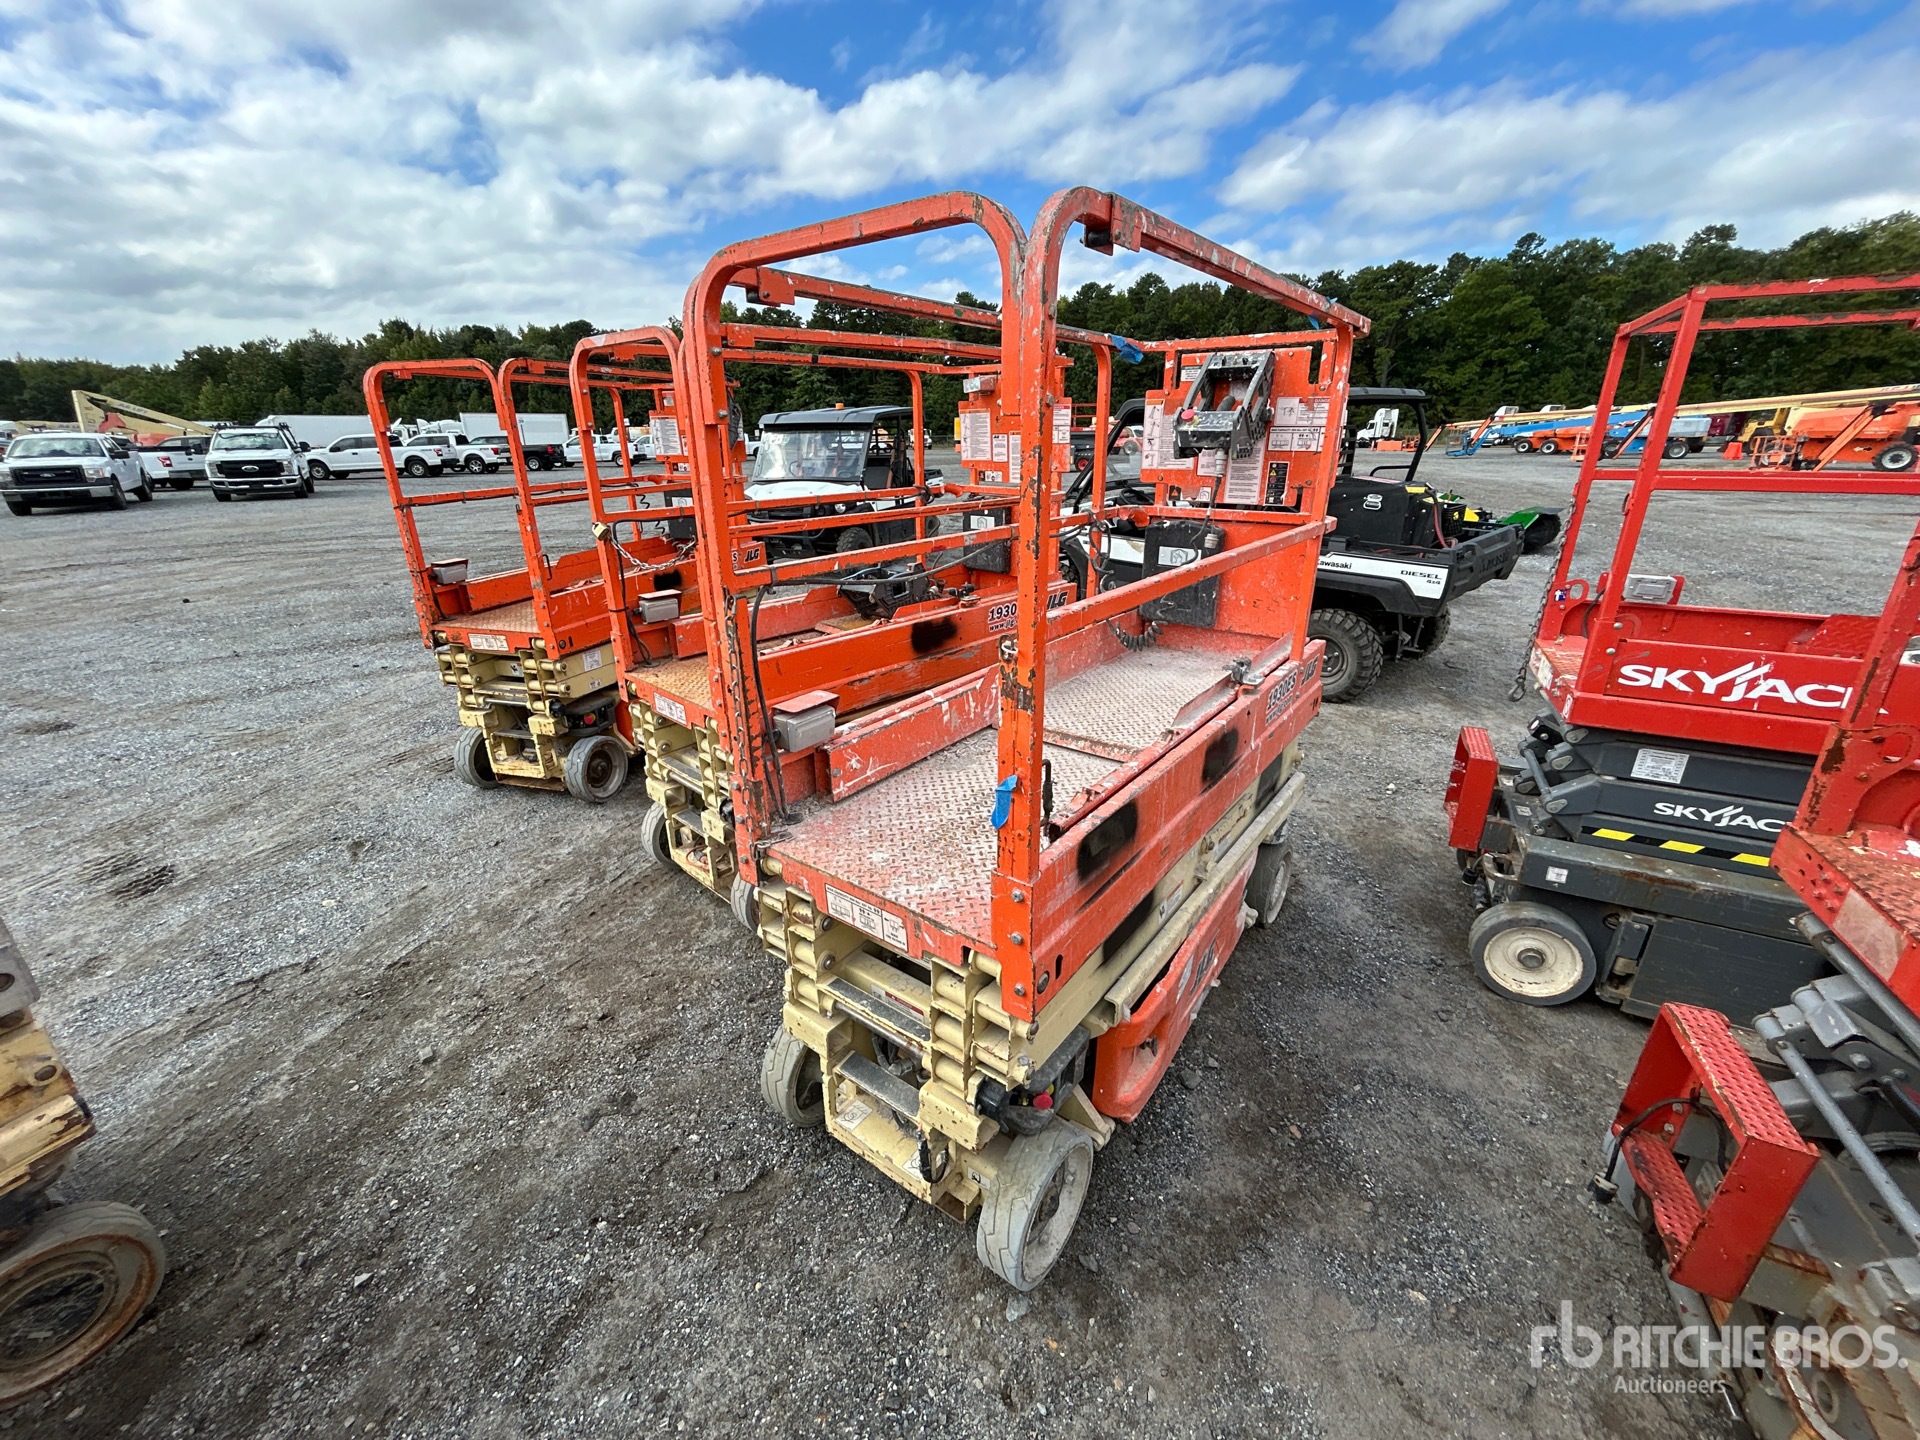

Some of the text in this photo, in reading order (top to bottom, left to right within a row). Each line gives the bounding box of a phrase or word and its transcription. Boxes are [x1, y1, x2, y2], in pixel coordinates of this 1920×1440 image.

[745, 548, 760, 563] JLG
[1401, 570, 1442, 579] DIESEL
[988, 602, 1018, 622] 1930
[1300, 656, 1318, 686] JLG
[1266, 671, 1297, 711] 1930ES
[1653, 802, 1786, 833] SKYJAC
